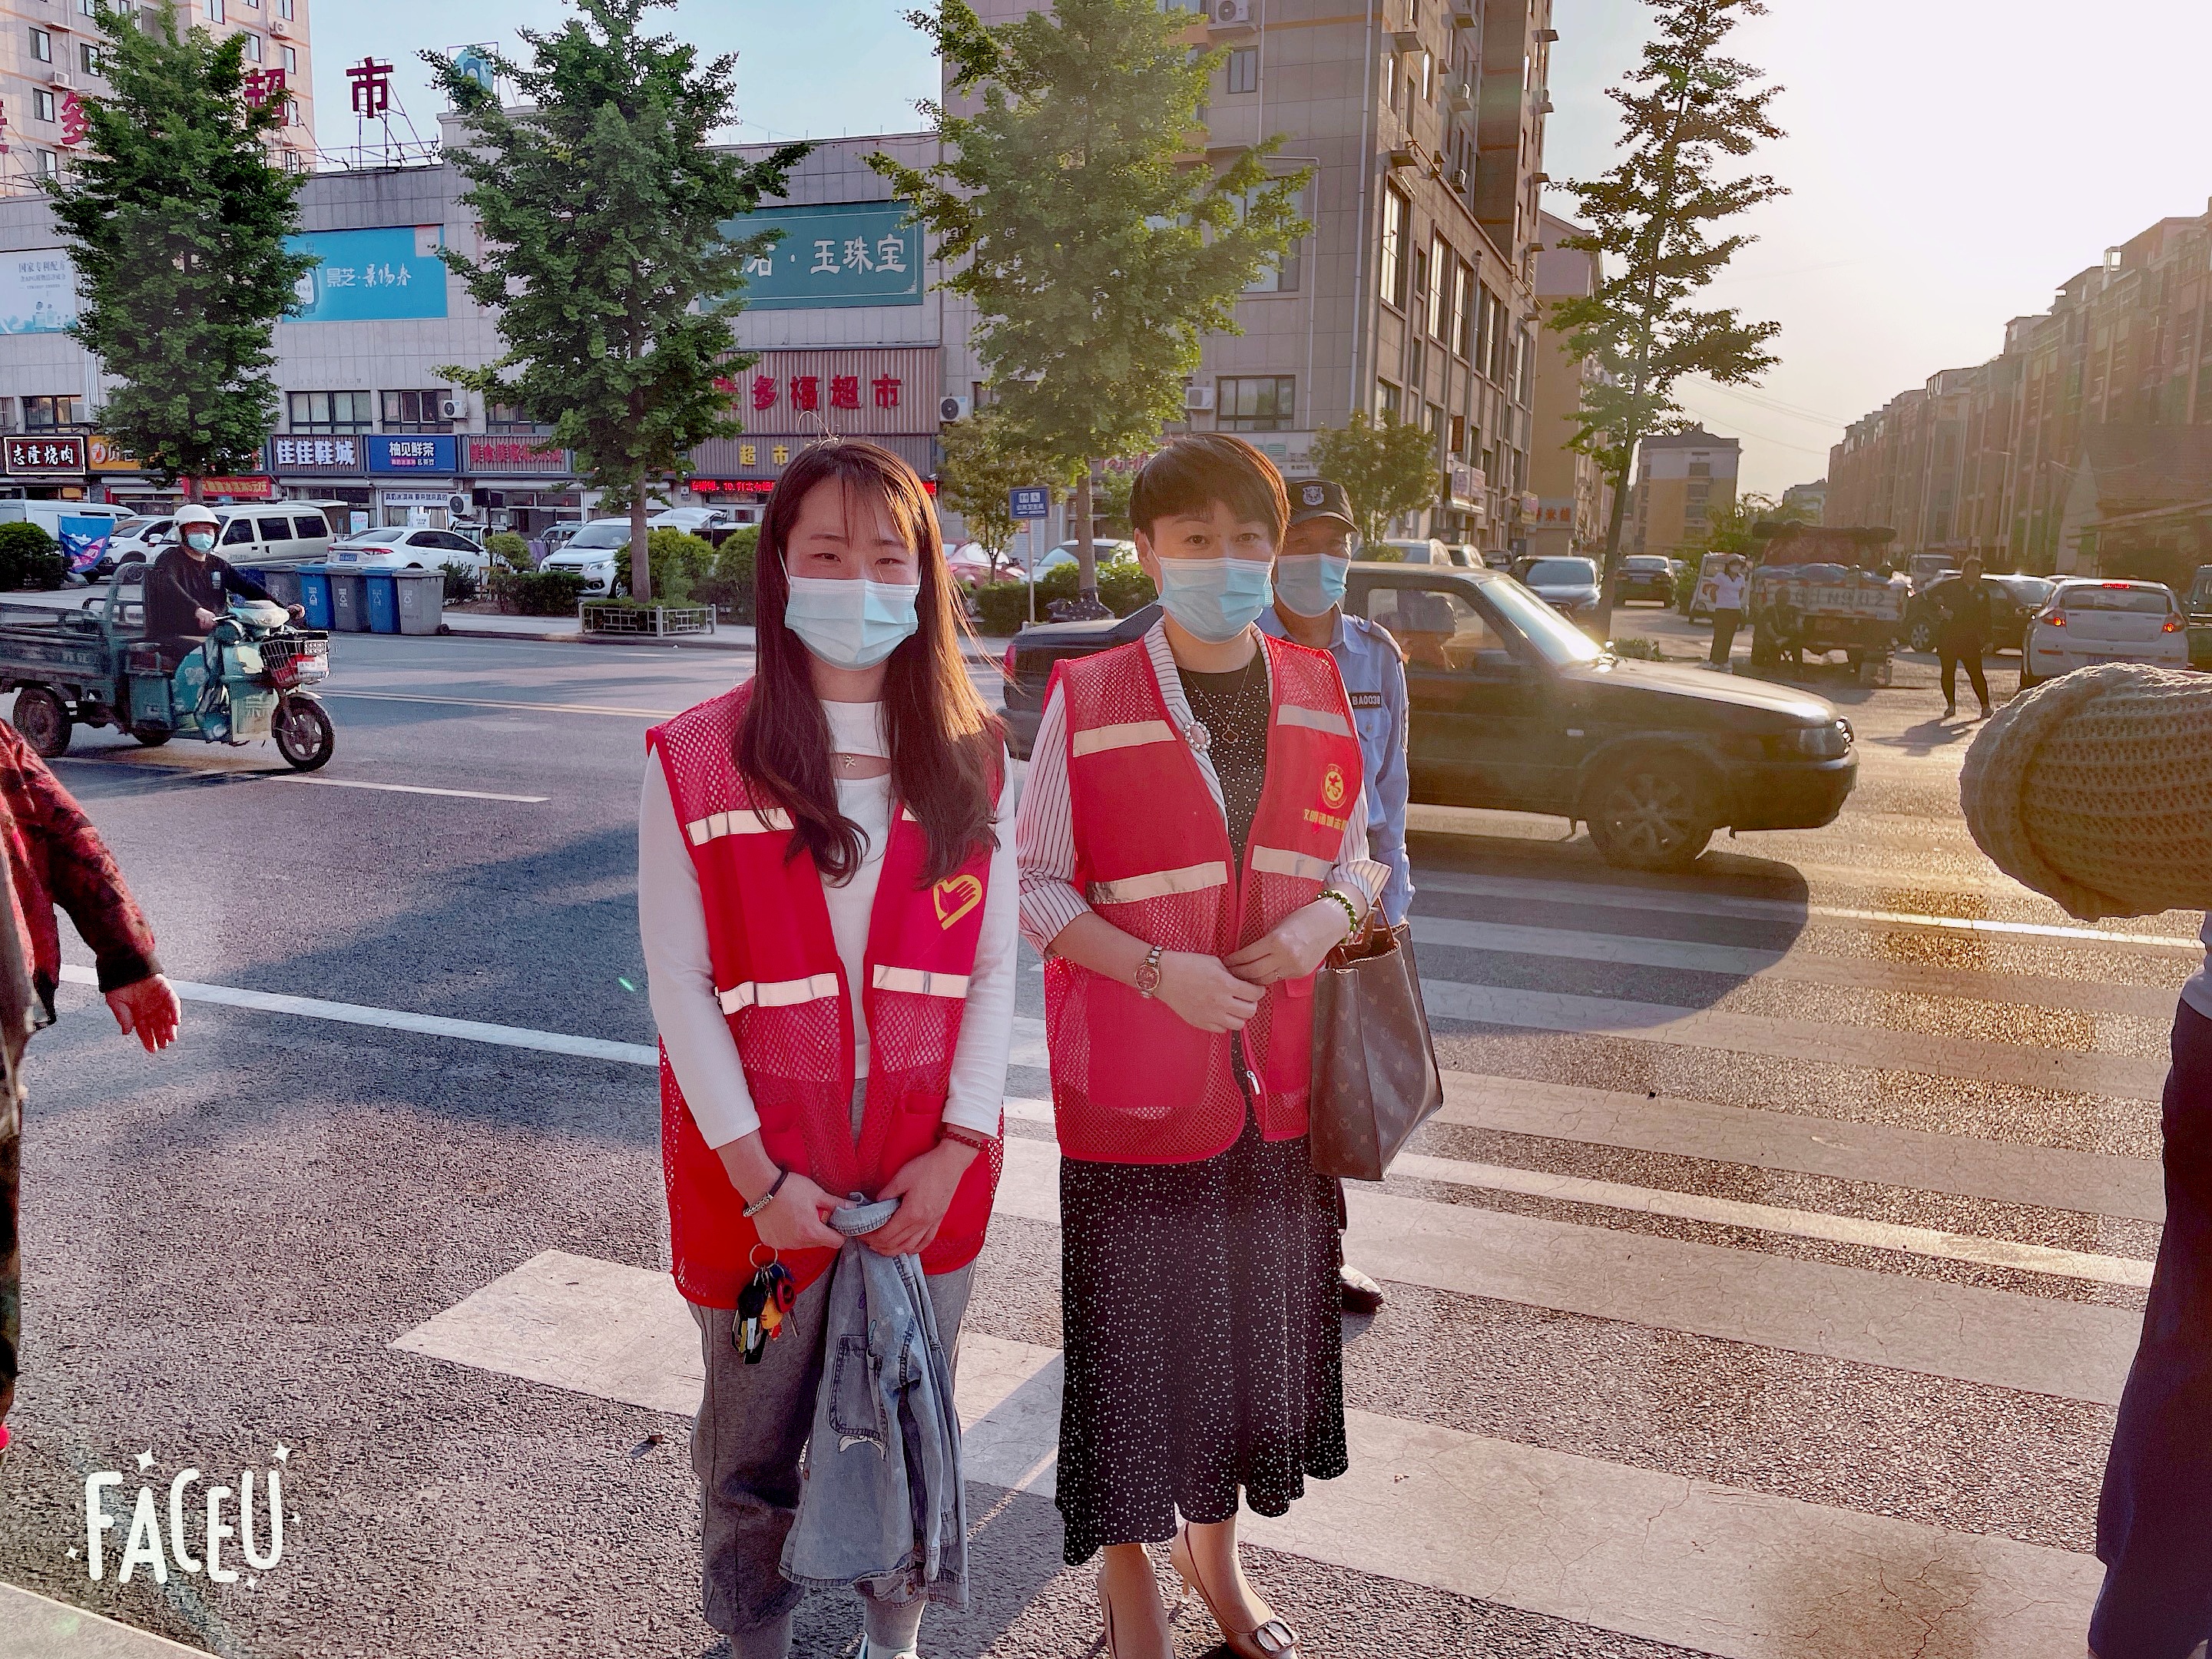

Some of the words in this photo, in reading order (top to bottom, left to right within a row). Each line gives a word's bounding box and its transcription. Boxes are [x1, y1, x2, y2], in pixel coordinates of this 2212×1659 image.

[12, 444, 74, 465] 志隆烧肉
[276, 439, 356, 465] 佳佳鞋城
[389, 442, 435, 457] 柚见鲜茶
[739, 443, 790, 466] 超市
